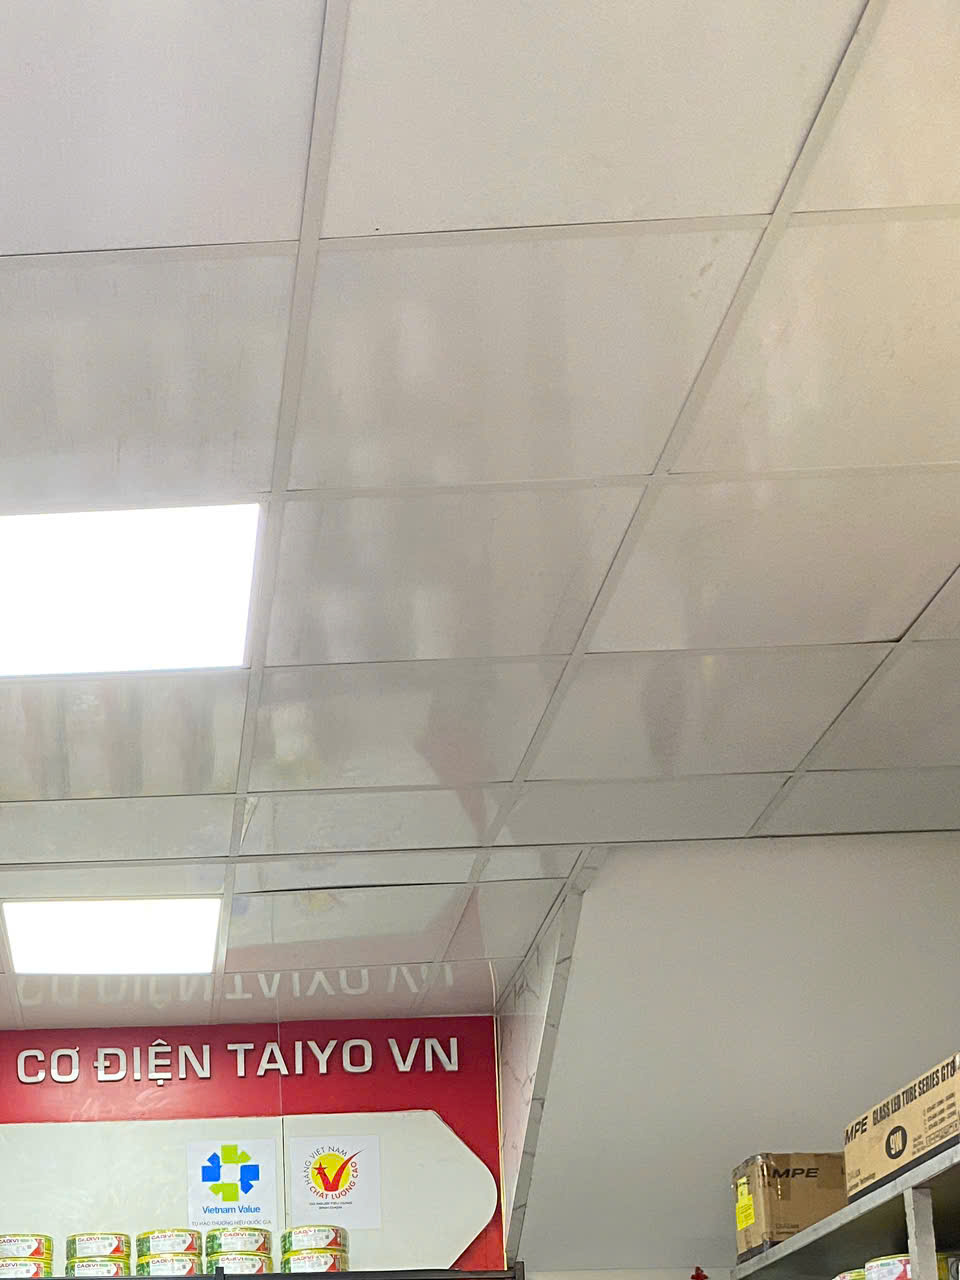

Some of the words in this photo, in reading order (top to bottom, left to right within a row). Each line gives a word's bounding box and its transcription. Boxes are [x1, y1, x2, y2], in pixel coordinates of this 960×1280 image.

[17, 1046, 80, 1083] CƠ
[94, 1039, 210, 1086] ĐIỆN
[227, 1039, 372, 1076] TAIYO
[387, 1037, 458, 1072] VN
[845, 1116, 868, 1145] MPE
[873, 1101, 890, 1126] GLASS
[891, 1094, 900, 1114] LED
[902, 1084, 917, 1107] TUBE
[918, 1069, 939, 1096] SERIES
[328, 1146, 347, 1157] NAM
[890, 1130, 903, 1155] 9W
[773, 1168, 819, 1178] MPE
[202, 1206, 236, 1214] Vietnam
